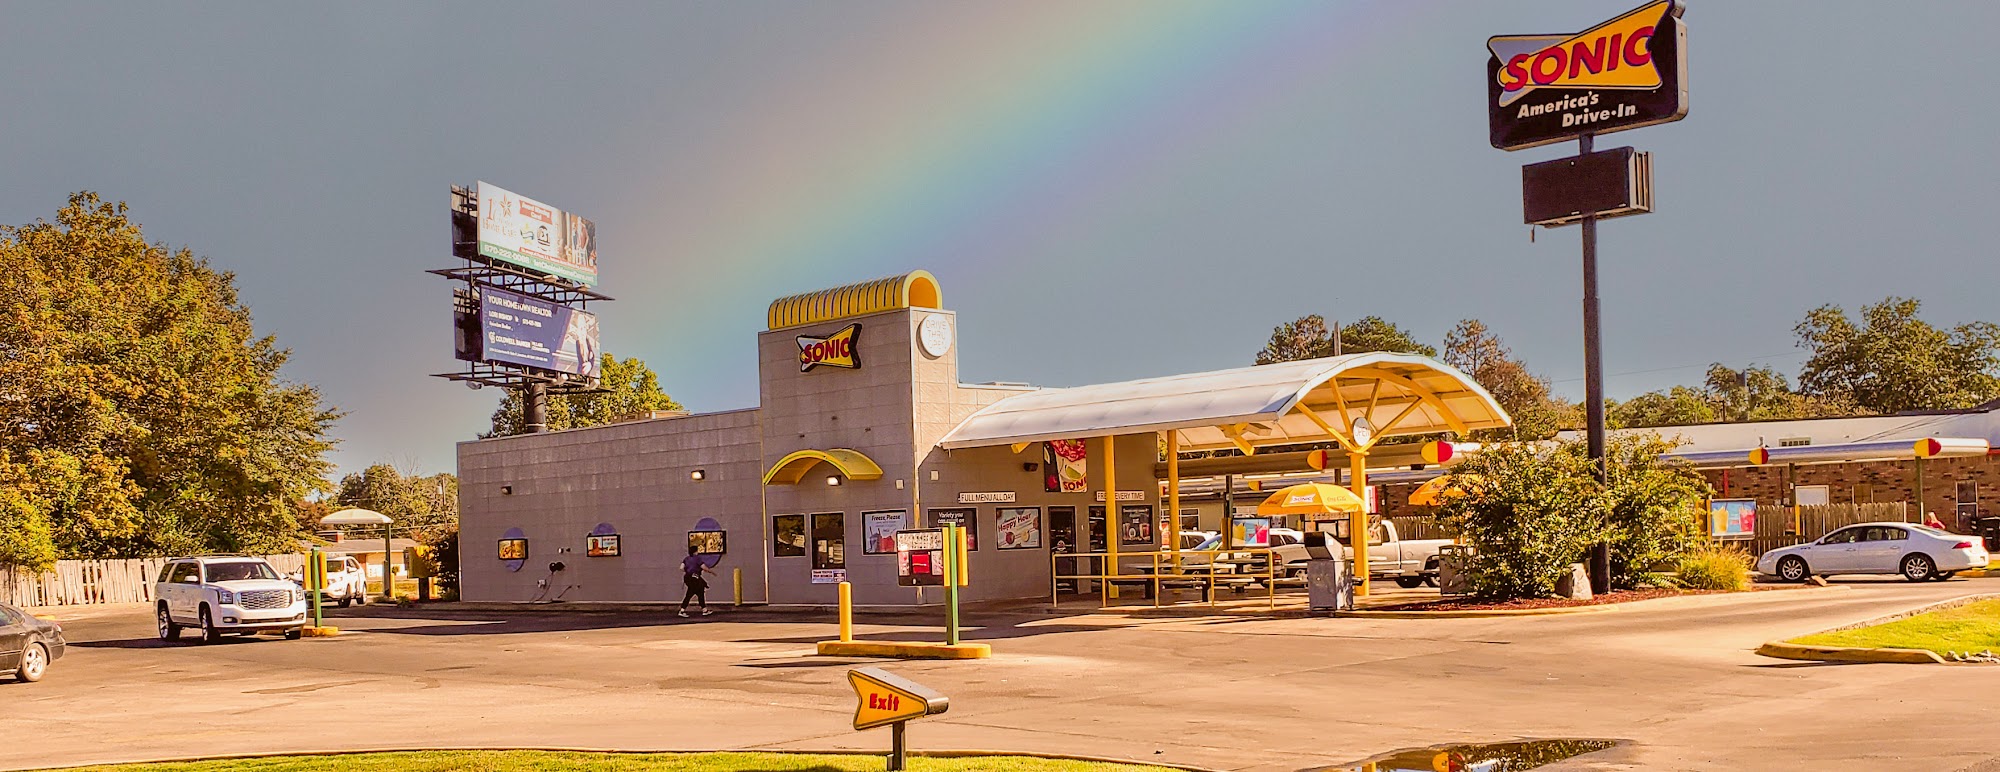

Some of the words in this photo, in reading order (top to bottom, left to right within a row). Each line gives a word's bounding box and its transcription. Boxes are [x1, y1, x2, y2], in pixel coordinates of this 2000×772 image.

[1503, 26, 1655, 92] SONIC
[1517, 91, 1600, 119] America's
[487, 295, 503, 306] YOUR
[802, 336, 851, 364] SONIC
[961, 494, 975, 502] FULL
[993, 493, 1003, 501] ALL
[1003, 493, 1014, 501] DAY
[1115, 492, 1130, 500] EVERY
[998, 520, 1017, 532] Happy
[1017, 513, 1032, 523] Hour
[869, 693, 900, 711] Exit
